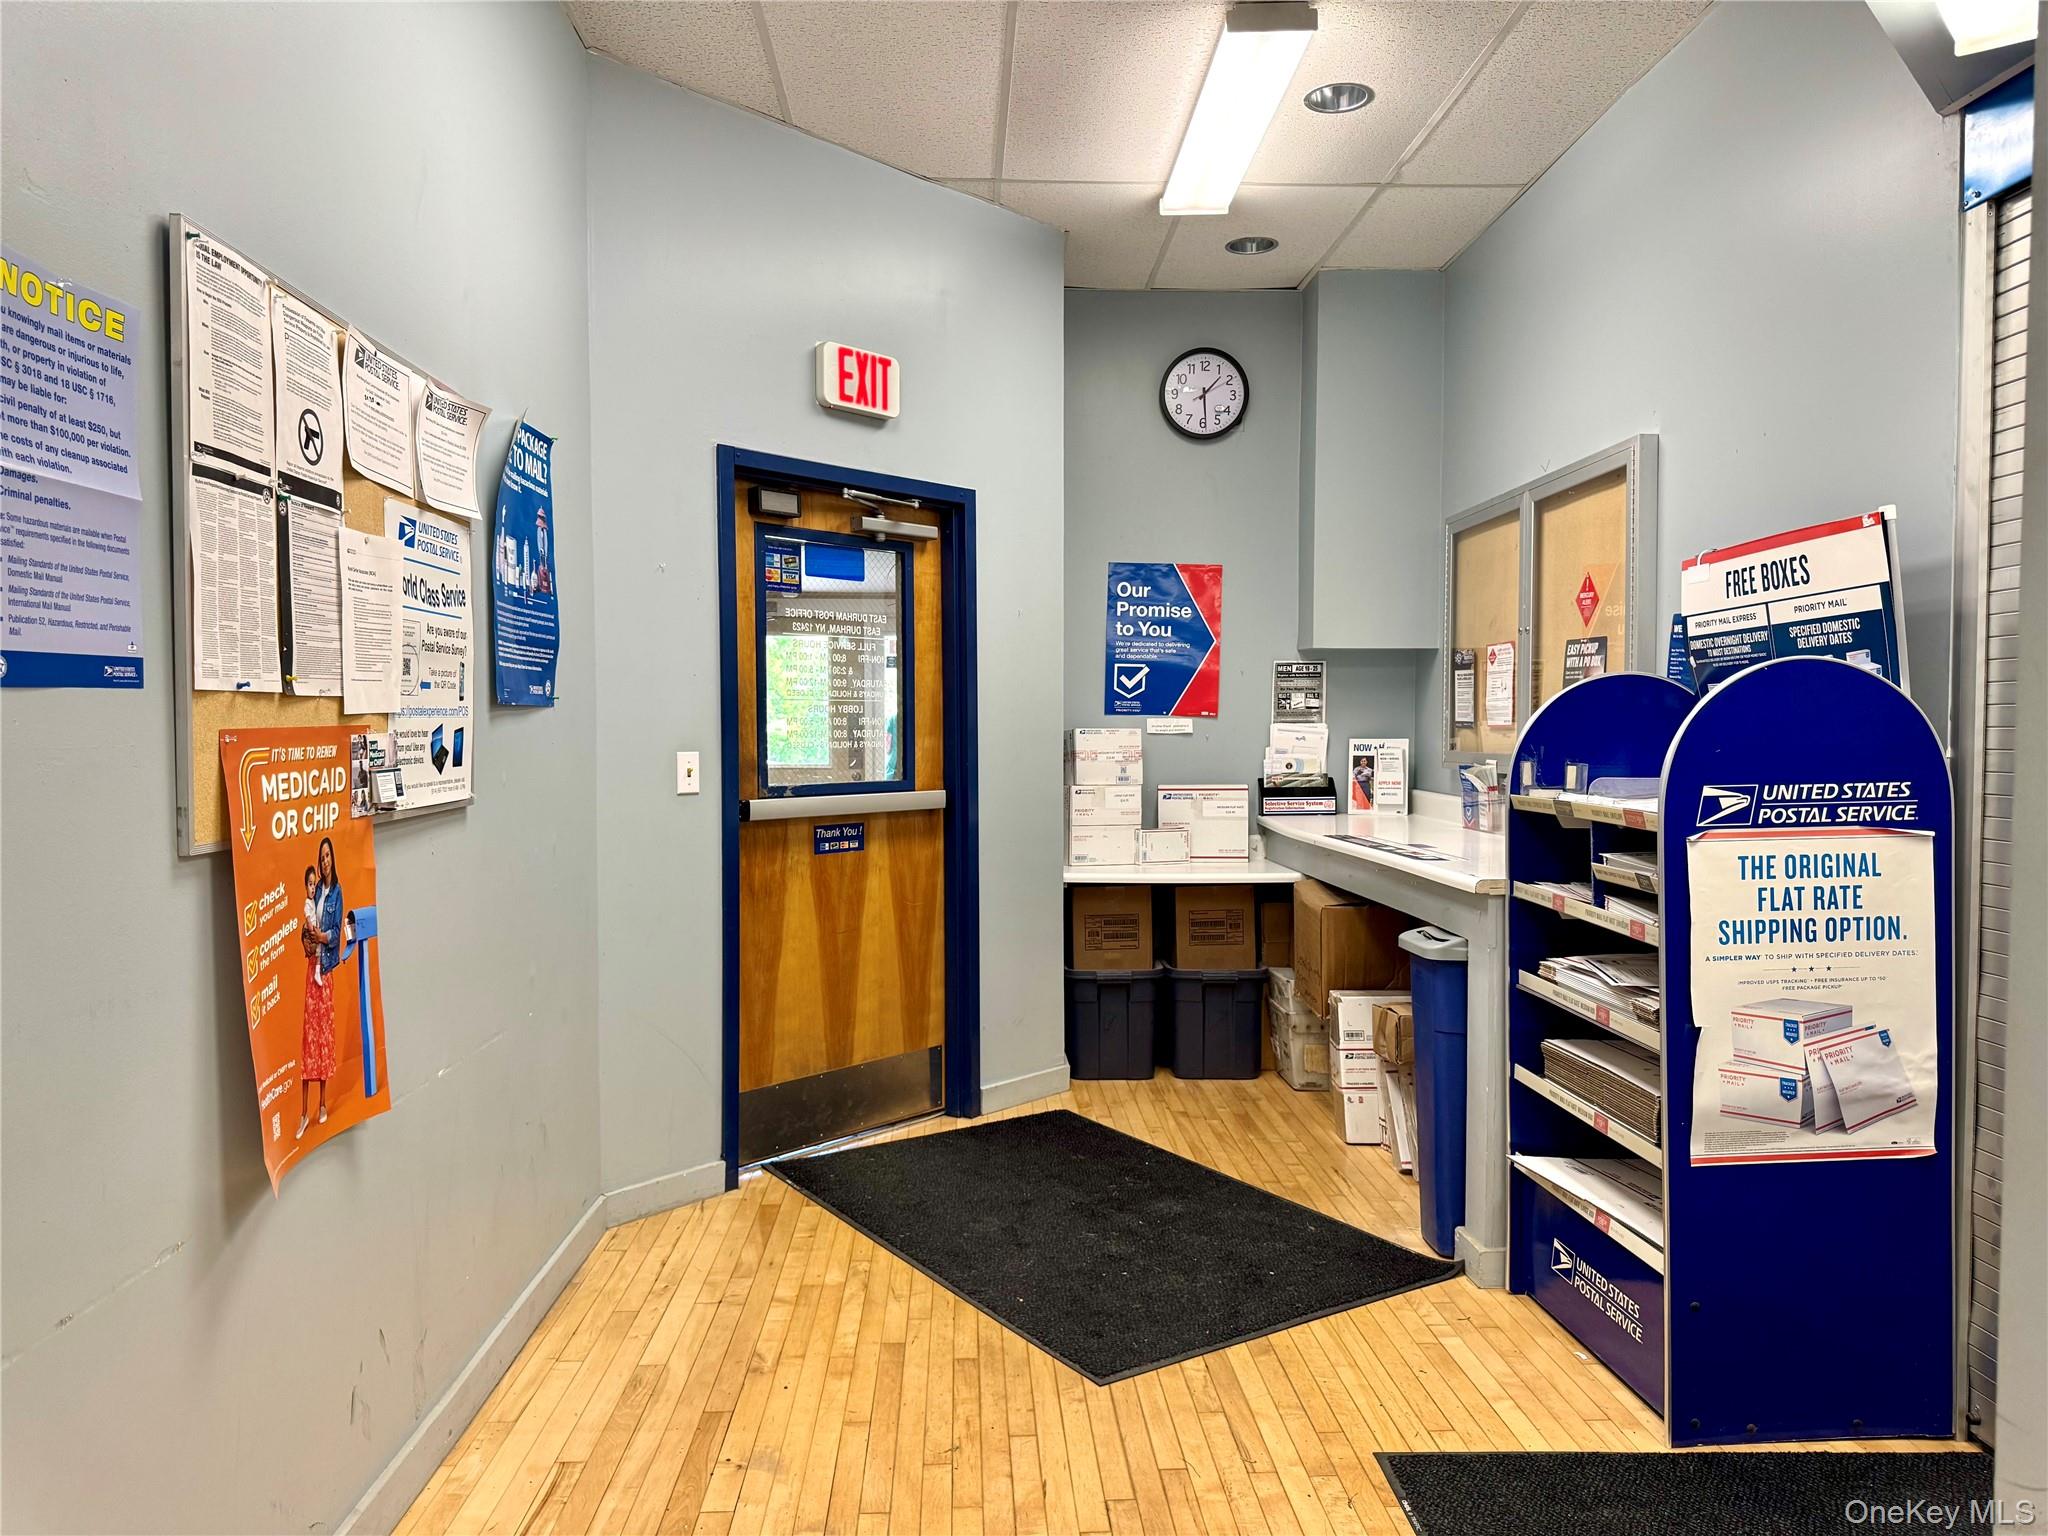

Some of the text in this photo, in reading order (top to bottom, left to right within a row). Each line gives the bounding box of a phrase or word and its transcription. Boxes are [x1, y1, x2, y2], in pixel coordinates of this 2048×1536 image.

[211, 257, 222, 272] LAW
[0, 257, 125, 342] NOTICE
[8, 309, 132, 365] knowingly mail items materials
[2, 325, 100, 370] are dangerous injurious
[22, 350, 97, 381] property violation
[365, 352, 382, 370] UNITED
[1188, 364, 1195, 374] 11
[1200, 361, 1210, 371] 12
[1217, 365, 1221, 375] 1
[22, 364, 88, 396] 3018 and USC
[838, 347, 891, 411] EXIT
[1176, 374, 1187, 384] 10
[1226, 375, 1233, 385] 2
[30, 384, 52, 400] liable
[1172, 389, 1178, 399] 9
[1230, 390, 1236, 400] 3
[448, 402, 468, 416] STATES
[1176, 404, 1182, 414] 8
[1224, 406, 1231, 415] 4
[17, 400, 121, 440] penalty least $250, but
[1186, 414, 1193, 424] 7
[1200, 418, 1207, 428] 6
[1214, 415, 1220, 425] 5
[7, 415, 131, 458] more than $100,000 violation.
[517, 428, 548, 460] PACKAGE
[11, 432, 128, 474] costs cleanup associated
[15, 451, 73, 474] each violation.
[525, 458, 548, 484] MAIL?
[34, 494, 71, 510] penalties.
[418, 522, 458, 545] UNITED STATES
[417, 539, 459, 563] POSTAL SERVICE
[7, 555, 27, 567] Mailing
[1726, 554, 1810, 599] FREE BOXES
[420, 578, 441, 608] Class
[441, 583, 466, 608] Service
[1117, 582, 1151, 598] Our
[1117, 601, 1192, 618] Promise
[1794, 598, 1847, 613] PRIORITY MAIL
[8, 614, 37, 624] Publication
[1695, 620, 1717, 629] PRIORITY
[1733, 613, 1757, 623] EXPRESS
[1116, 622, 1171, 637] to You
[1789, 618, 1860, 638] SPECIFIED DOMESTIC
[422, 639, 467, 658] Postal Service Survey?
[1567, 643, 1599, 655] EASY PICKUP
[1690, 631, 1768, 650] DOMESTIC OVERNIGHT DELIVERY
[1797, 632, 1852, 649] DELIVERY DATES
[1724, 645, 1751, 655] DESTINATIONS
[1566, 656, 1578, 667] WITH
[271, 745, 337, 762] IT'S TIME TO RENEW
[261, 766, 346, 802] MEDICAID
[1762, 782, 1911, 801] UNITED STATES
[272, 801, 339, 840] OR CHIP
[1758, 806, 1832, 824] POSTAL
[816, 826, 857, 838] Thank You
[1738, 852, 1882, 880] THE ORIGINAL
[259, 881, 286, 911] check
[1757, 884, 1863, 912] FLAT RATE
[275, 896, 288, 917] mail
[259, 917, 298, 956] complete
[1718, 915, 1907, 945] SHIPPING OPTION.
[1854, 950, 1890, 958] DELIVERY
[261, 975, 278, 1002] mail
[1805, 1022, 1826, 1030] PRIORITY
[1824, 1047, 1853, 1060] PRIORITY
[1835, 1056, 1850, 1065] MAIL
[1576, 1257, 1640, 1319] UNITED STATES
[1574, 1275, 1643, 1344] POSTAL SERVICE
